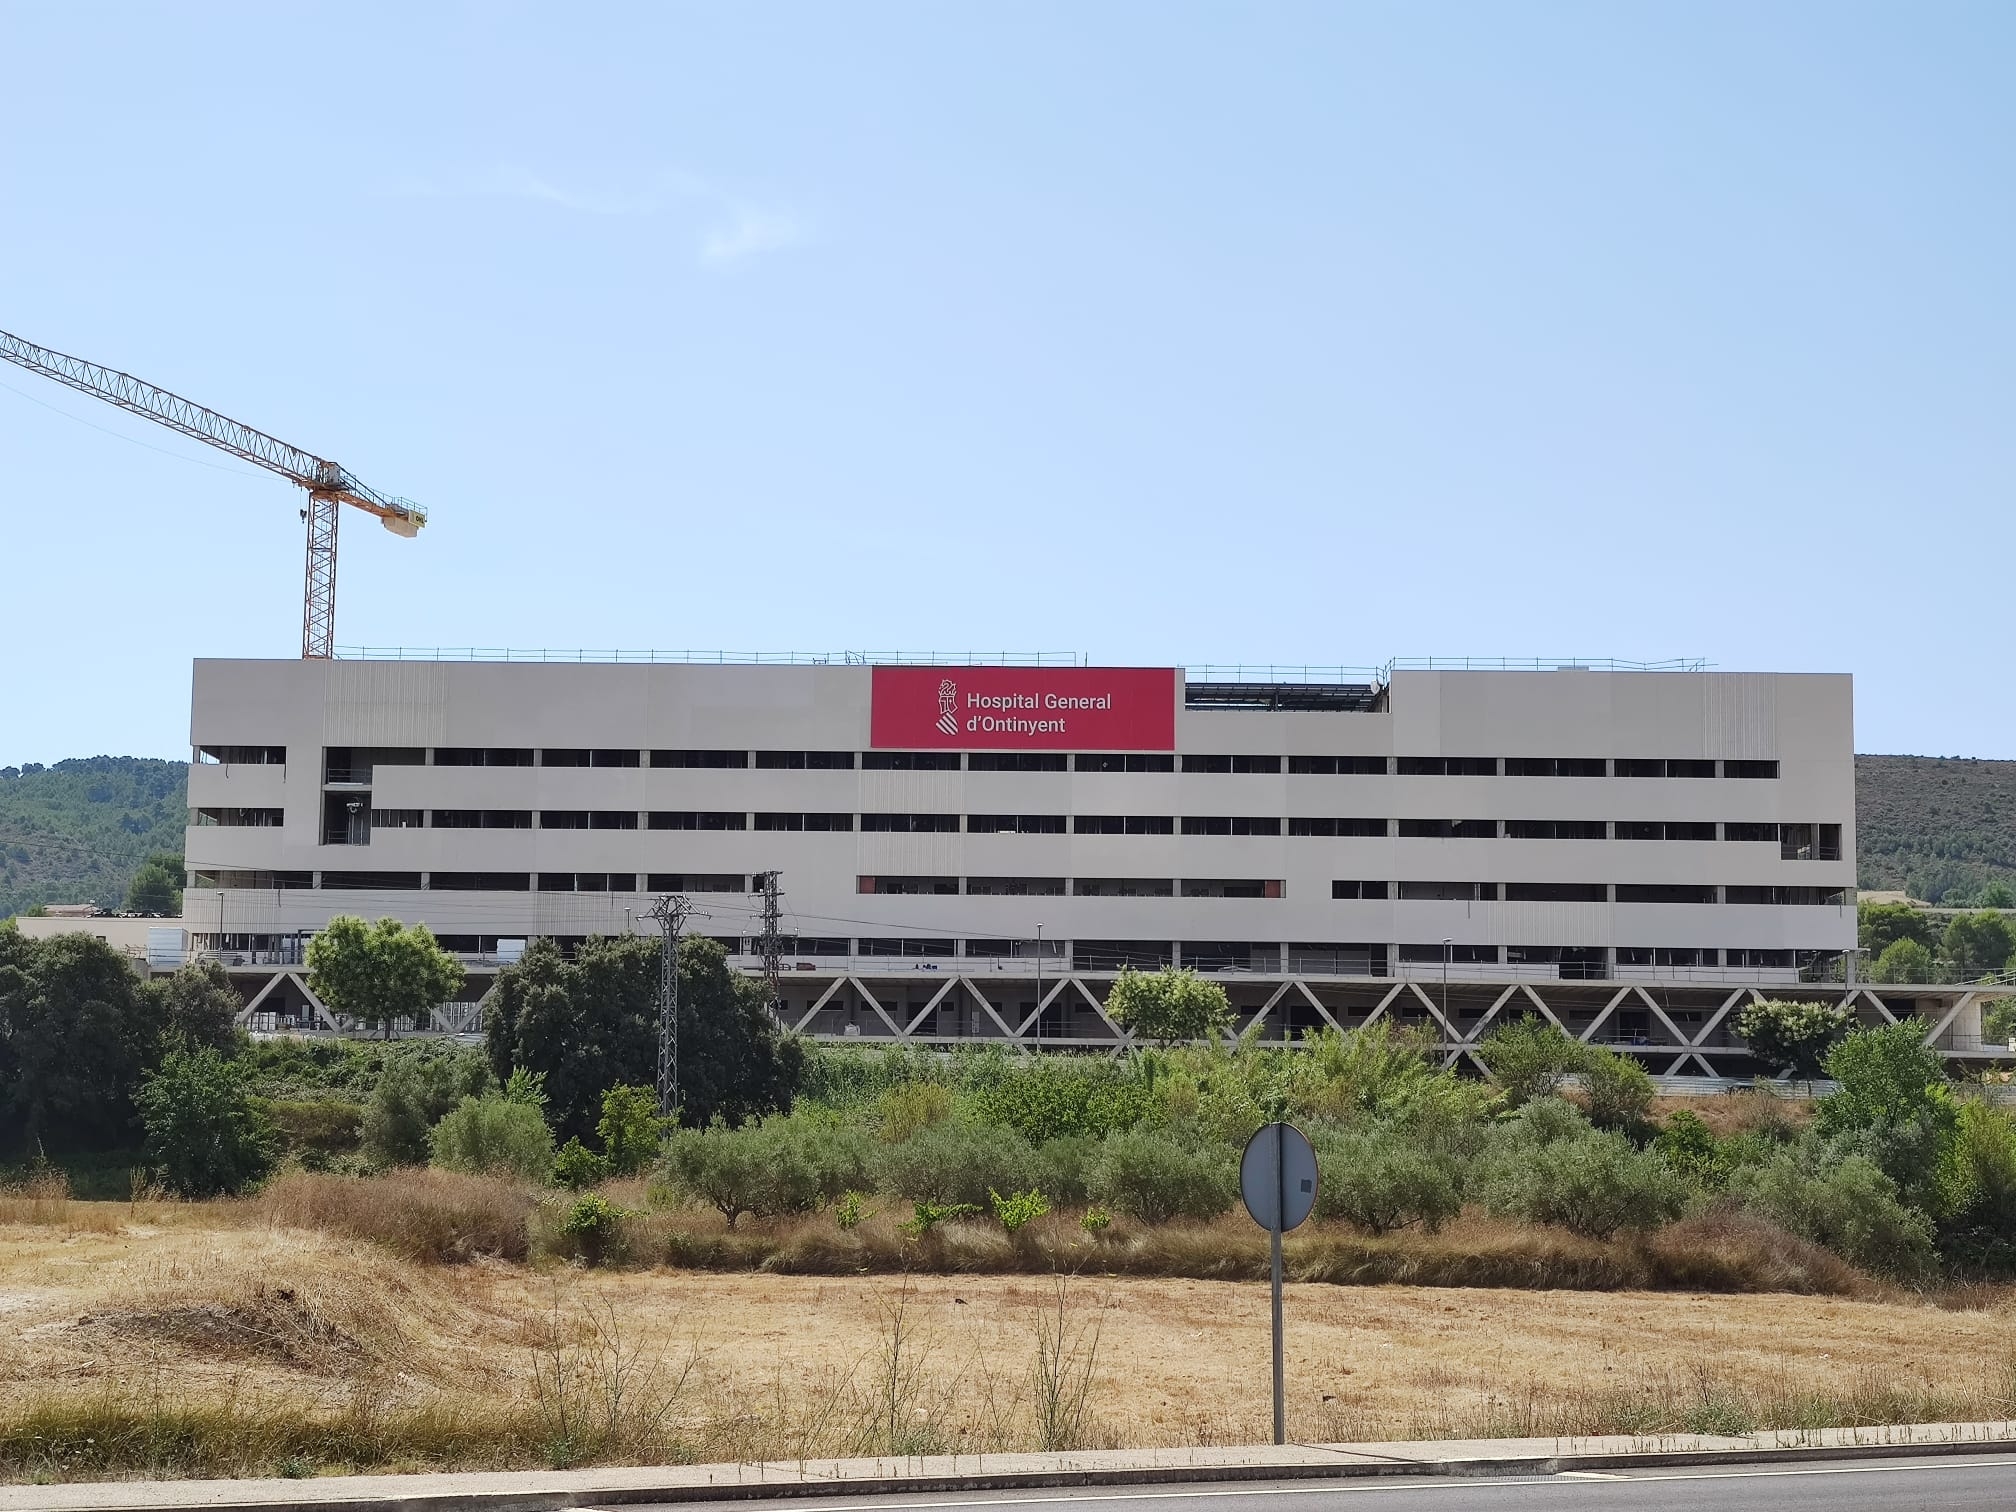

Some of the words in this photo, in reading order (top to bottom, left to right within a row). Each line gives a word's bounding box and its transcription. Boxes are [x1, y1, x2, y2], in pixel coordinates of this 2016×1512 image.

[967, 693, 1039, 712] Hospital
[1044, 693, 1111, 709] General
[966, 716, 1066, 735] d’Ontinyent
